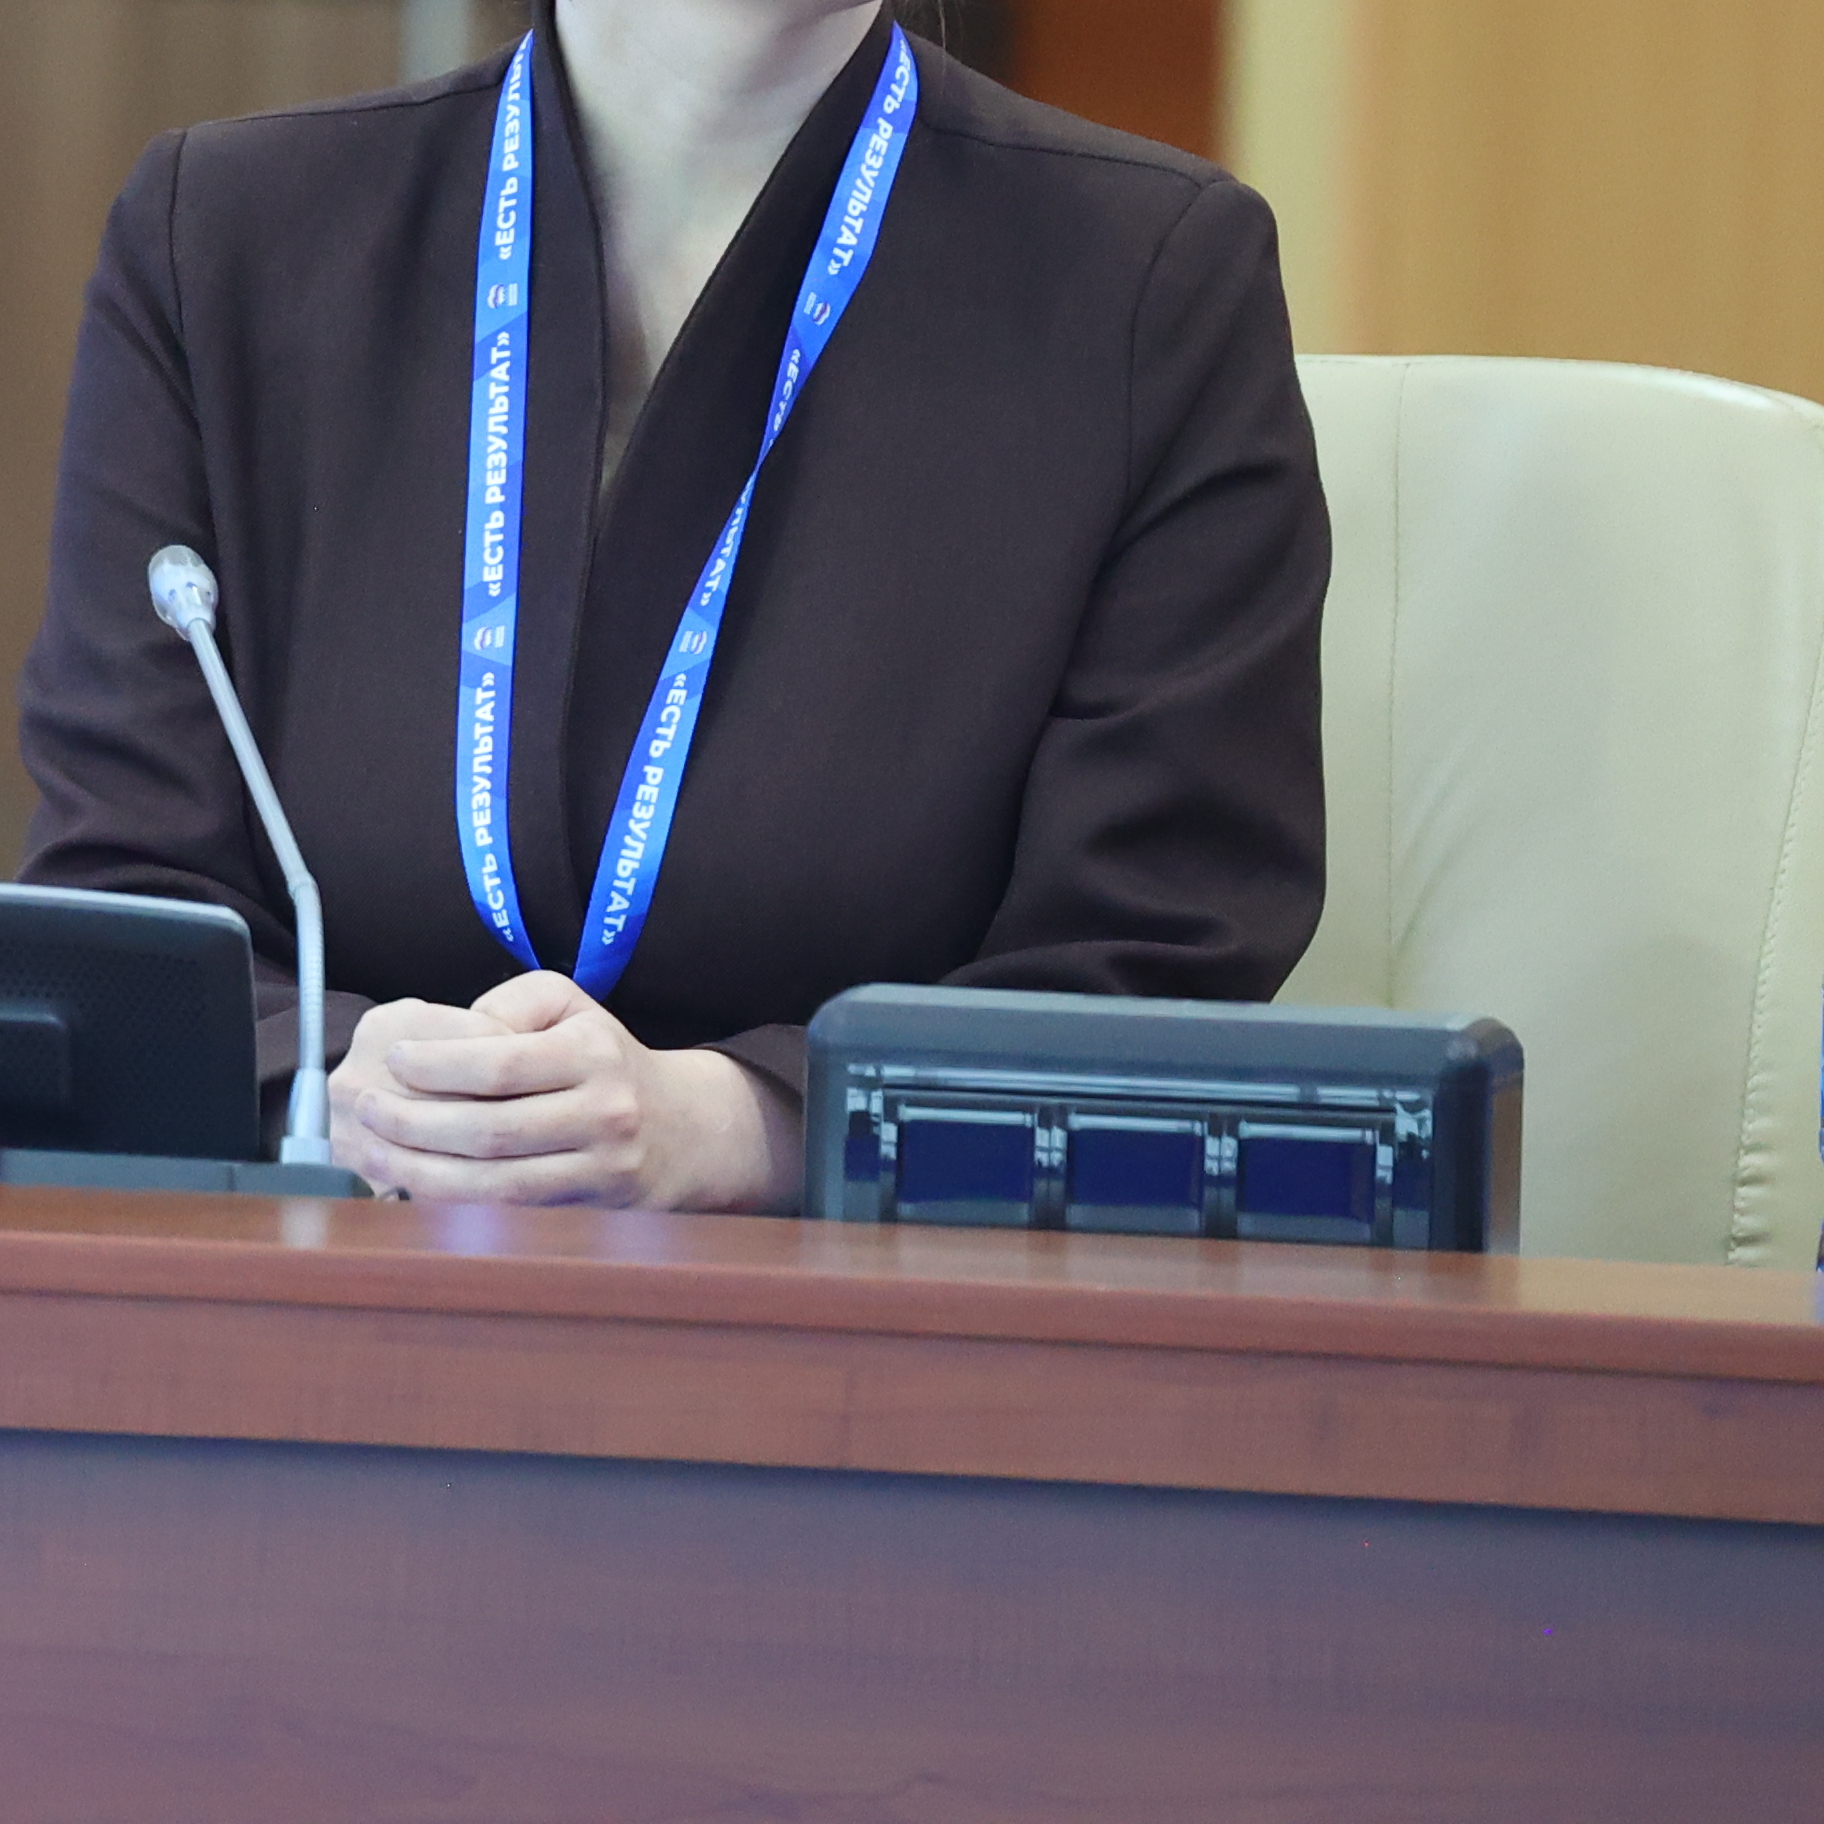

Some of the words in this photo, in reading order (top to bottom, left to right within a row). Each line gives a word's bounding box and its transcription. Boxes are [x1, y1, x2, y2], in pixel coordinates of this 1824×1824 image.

[495, 176, 519, 260] «ЕСТЬ
[827, 116, 894, 276] РЕЗУЛЬТАТ»
[484, 331, 511, 504] РЕЗУЛЬТАТ»
[483, 509, 506, 597] «ЕСТЬ
[471, 671, 496, 847] РЕЗУЛЬТАТ»
[649, 672, 688, 759] «ЕСТЬ
[481, 853, 515, 942] «ЕСТЬ
[601, 764, 665, 946] РЕЗУЛЬТАТ»
